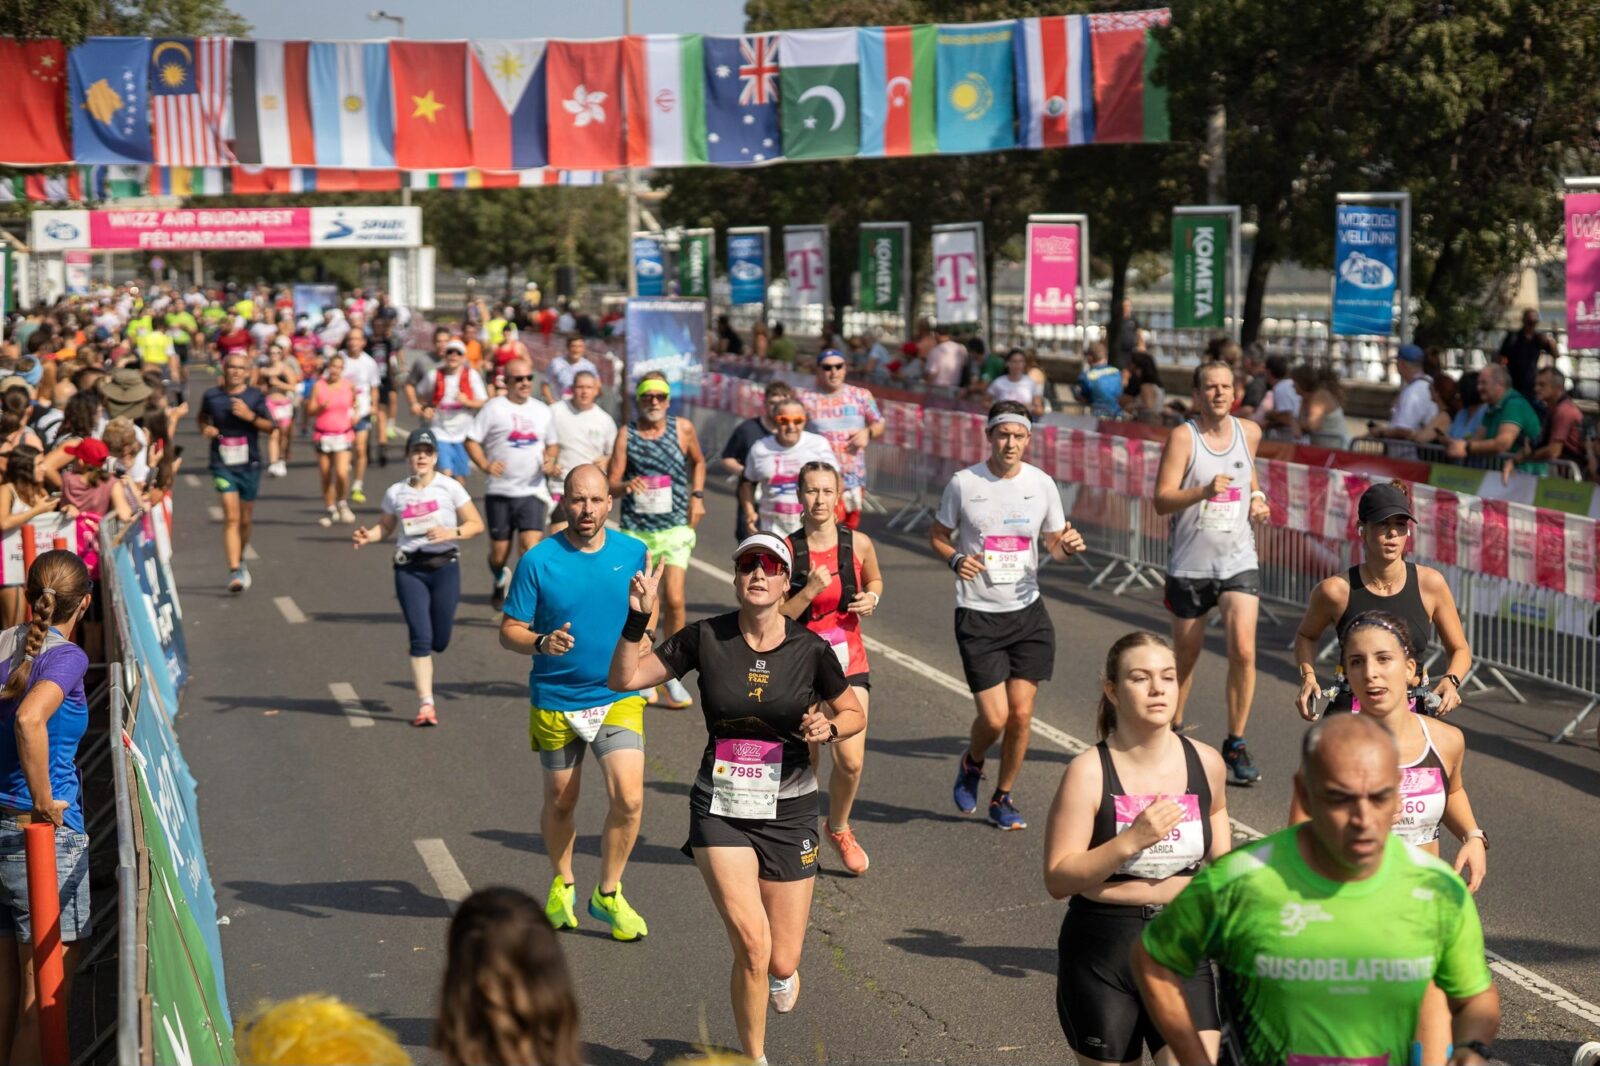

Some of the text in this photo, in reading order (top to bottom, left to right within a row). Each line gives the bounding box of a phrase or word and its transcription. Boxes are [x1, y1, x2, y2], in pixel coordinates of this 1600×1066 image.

[198, 210, 295, 227] BUDAPEST
[875, 238, 893, 306] KOMETA
[1193, 226, 1216, 319] KOMETA
[729, 766, 763, 779] 7985
[1148, 844, 1175, 855] SARICA
[1254, 953, 1436, 982] SUSODELAFUENTE
